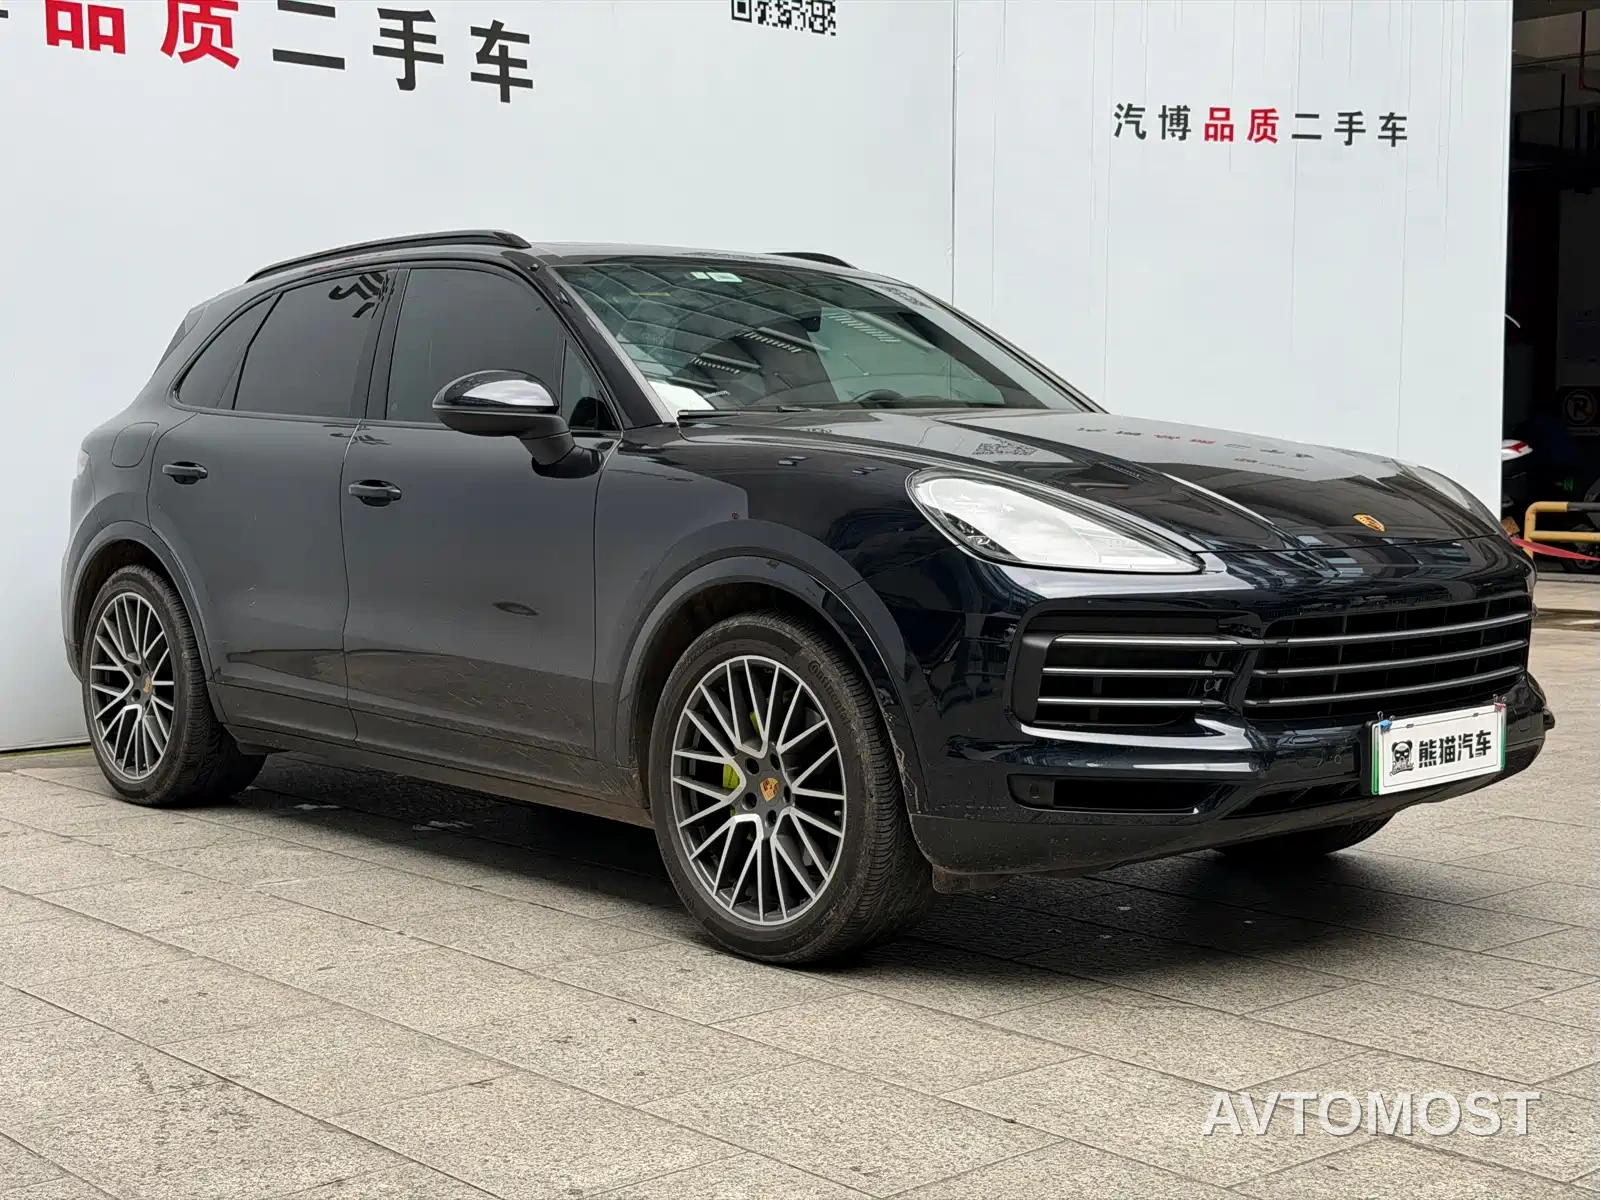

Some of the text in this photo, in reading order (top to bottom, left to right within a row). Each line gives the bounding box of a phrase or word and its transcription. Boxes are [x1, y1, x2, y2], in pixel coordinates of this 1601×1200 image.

[0, 0, 534, 103] 品质二手车
[1113, 103, 1408, 147] 汽博品质二手车
[1418, 730, 1492, 768] 熊猫汽车
